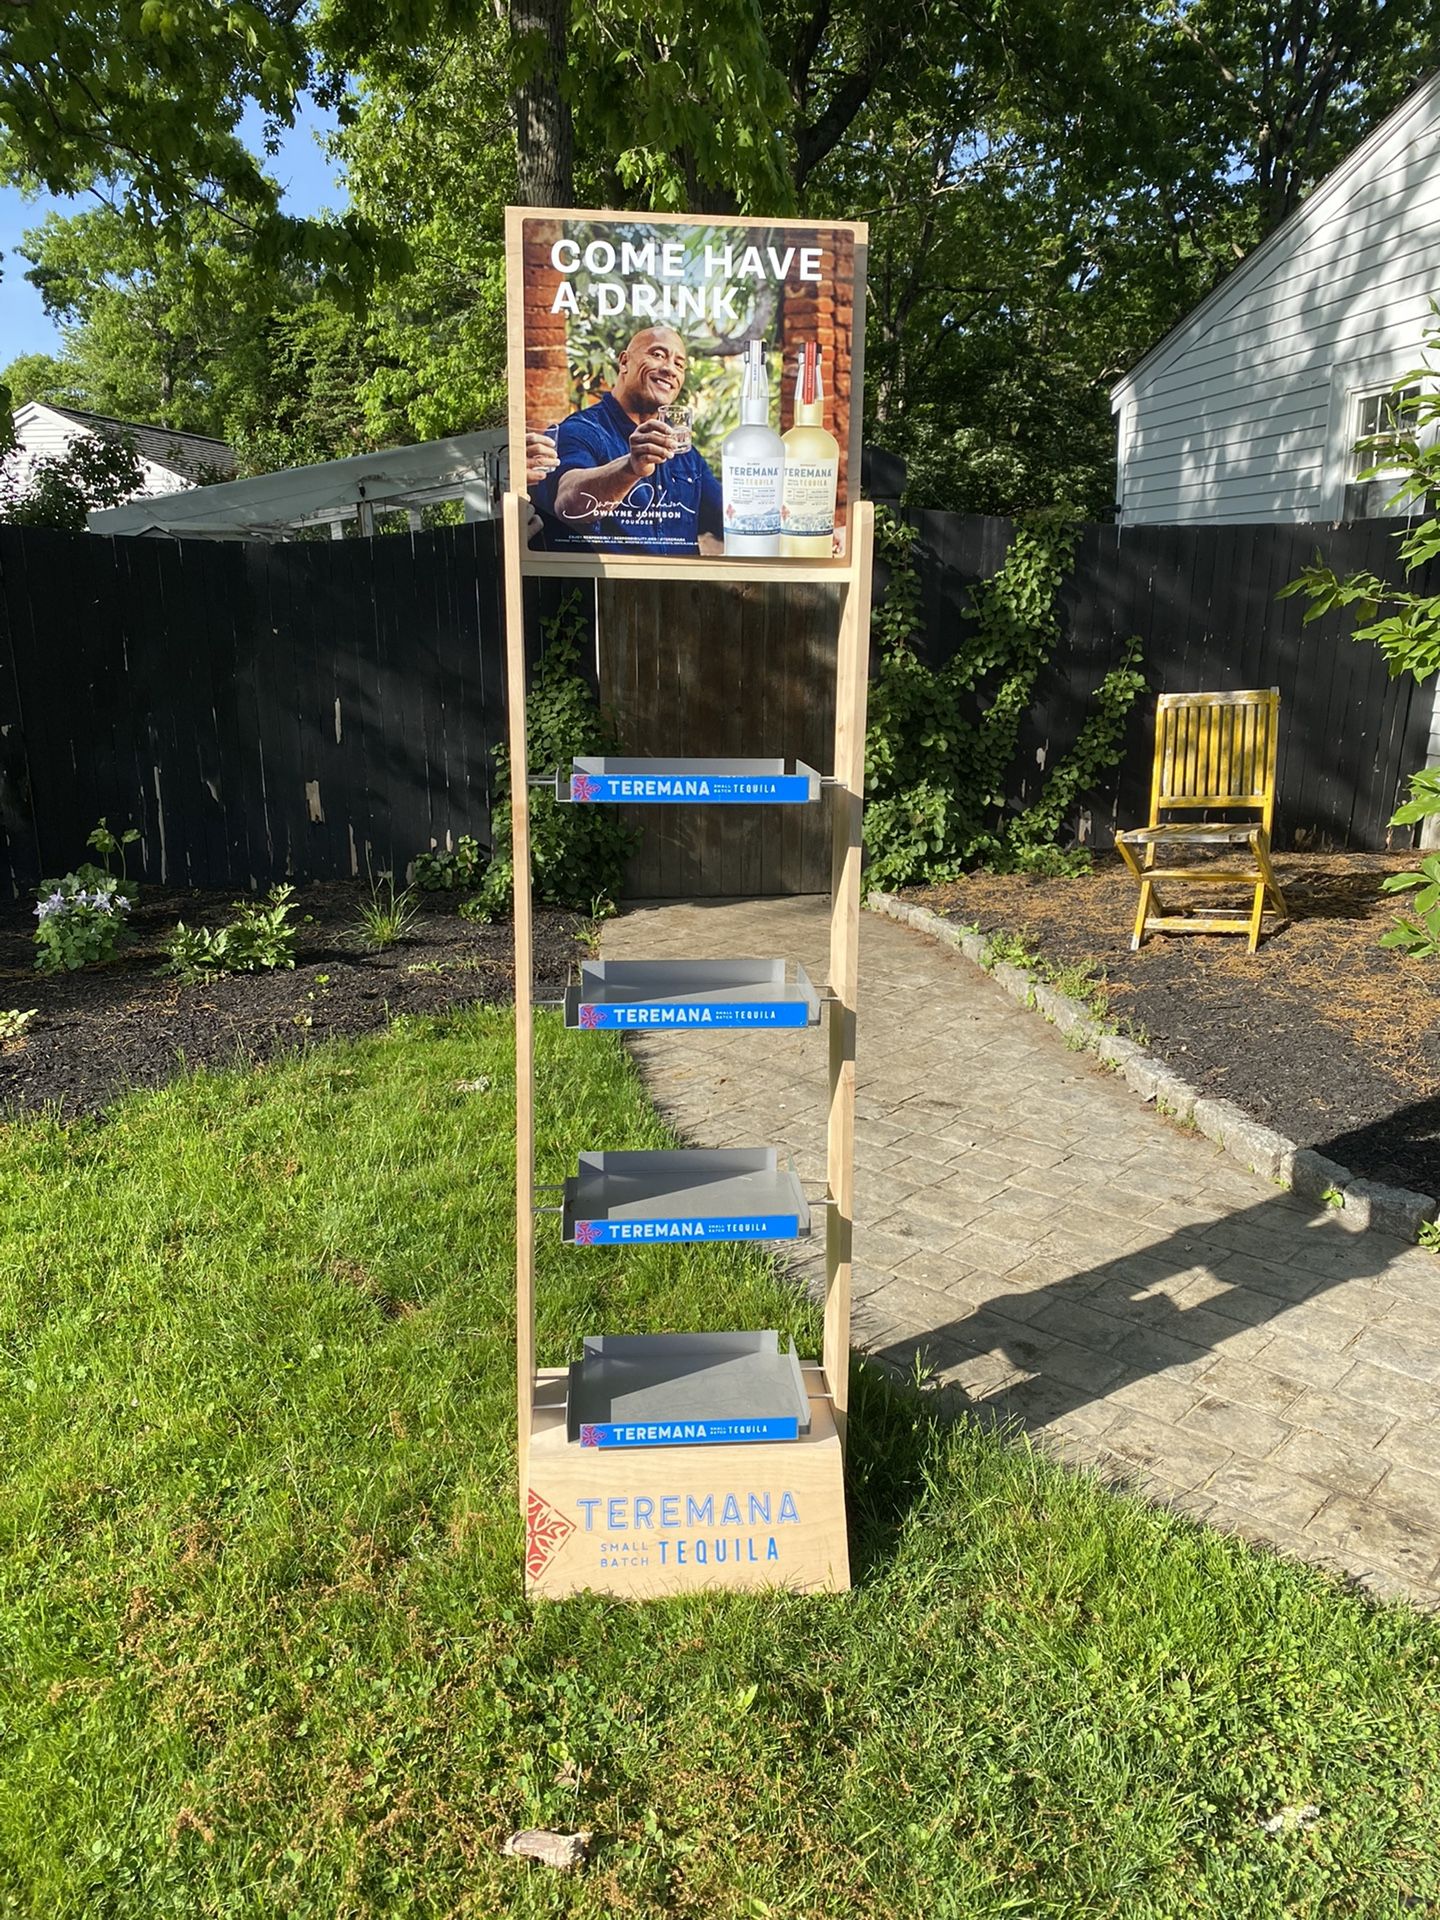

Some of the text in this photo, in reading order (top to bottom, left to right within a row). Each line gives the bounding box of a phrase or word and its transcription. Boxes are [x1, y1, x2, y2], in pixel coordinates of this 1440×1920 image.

[550, 239, 824, 281] COME HAVE
[550, 281, 740, 320] A DRINK
[729, 466, 778, 477] TEREMANA
[784, 467, 832, 478] TEREMANA
[593, 510, 681, 518] DWAYNE JOHNSON
[608, 780, 710, 796] TEREMANA
[734, 784, 776, 793] TEQUILA
[613, 1008, 712, 1023] TEREMANA
[735, 1010, 776, 1020] TEQUILA
[609, 1222, 705, 1238] TEREMANA
[727, 1223, 767, 1232] TEQUILA
[613, 1424, 707, 1441] TEREMANA
[728, 1425, 768, 1434] TEQUILA
[576, 1491, 800, 1531] TEREMANA
[600, 1541, 649, 1552] SMALL
[658, 1537, 779, 1564] TEQUILA
[600, 1557, 649, 1568] BATCH
